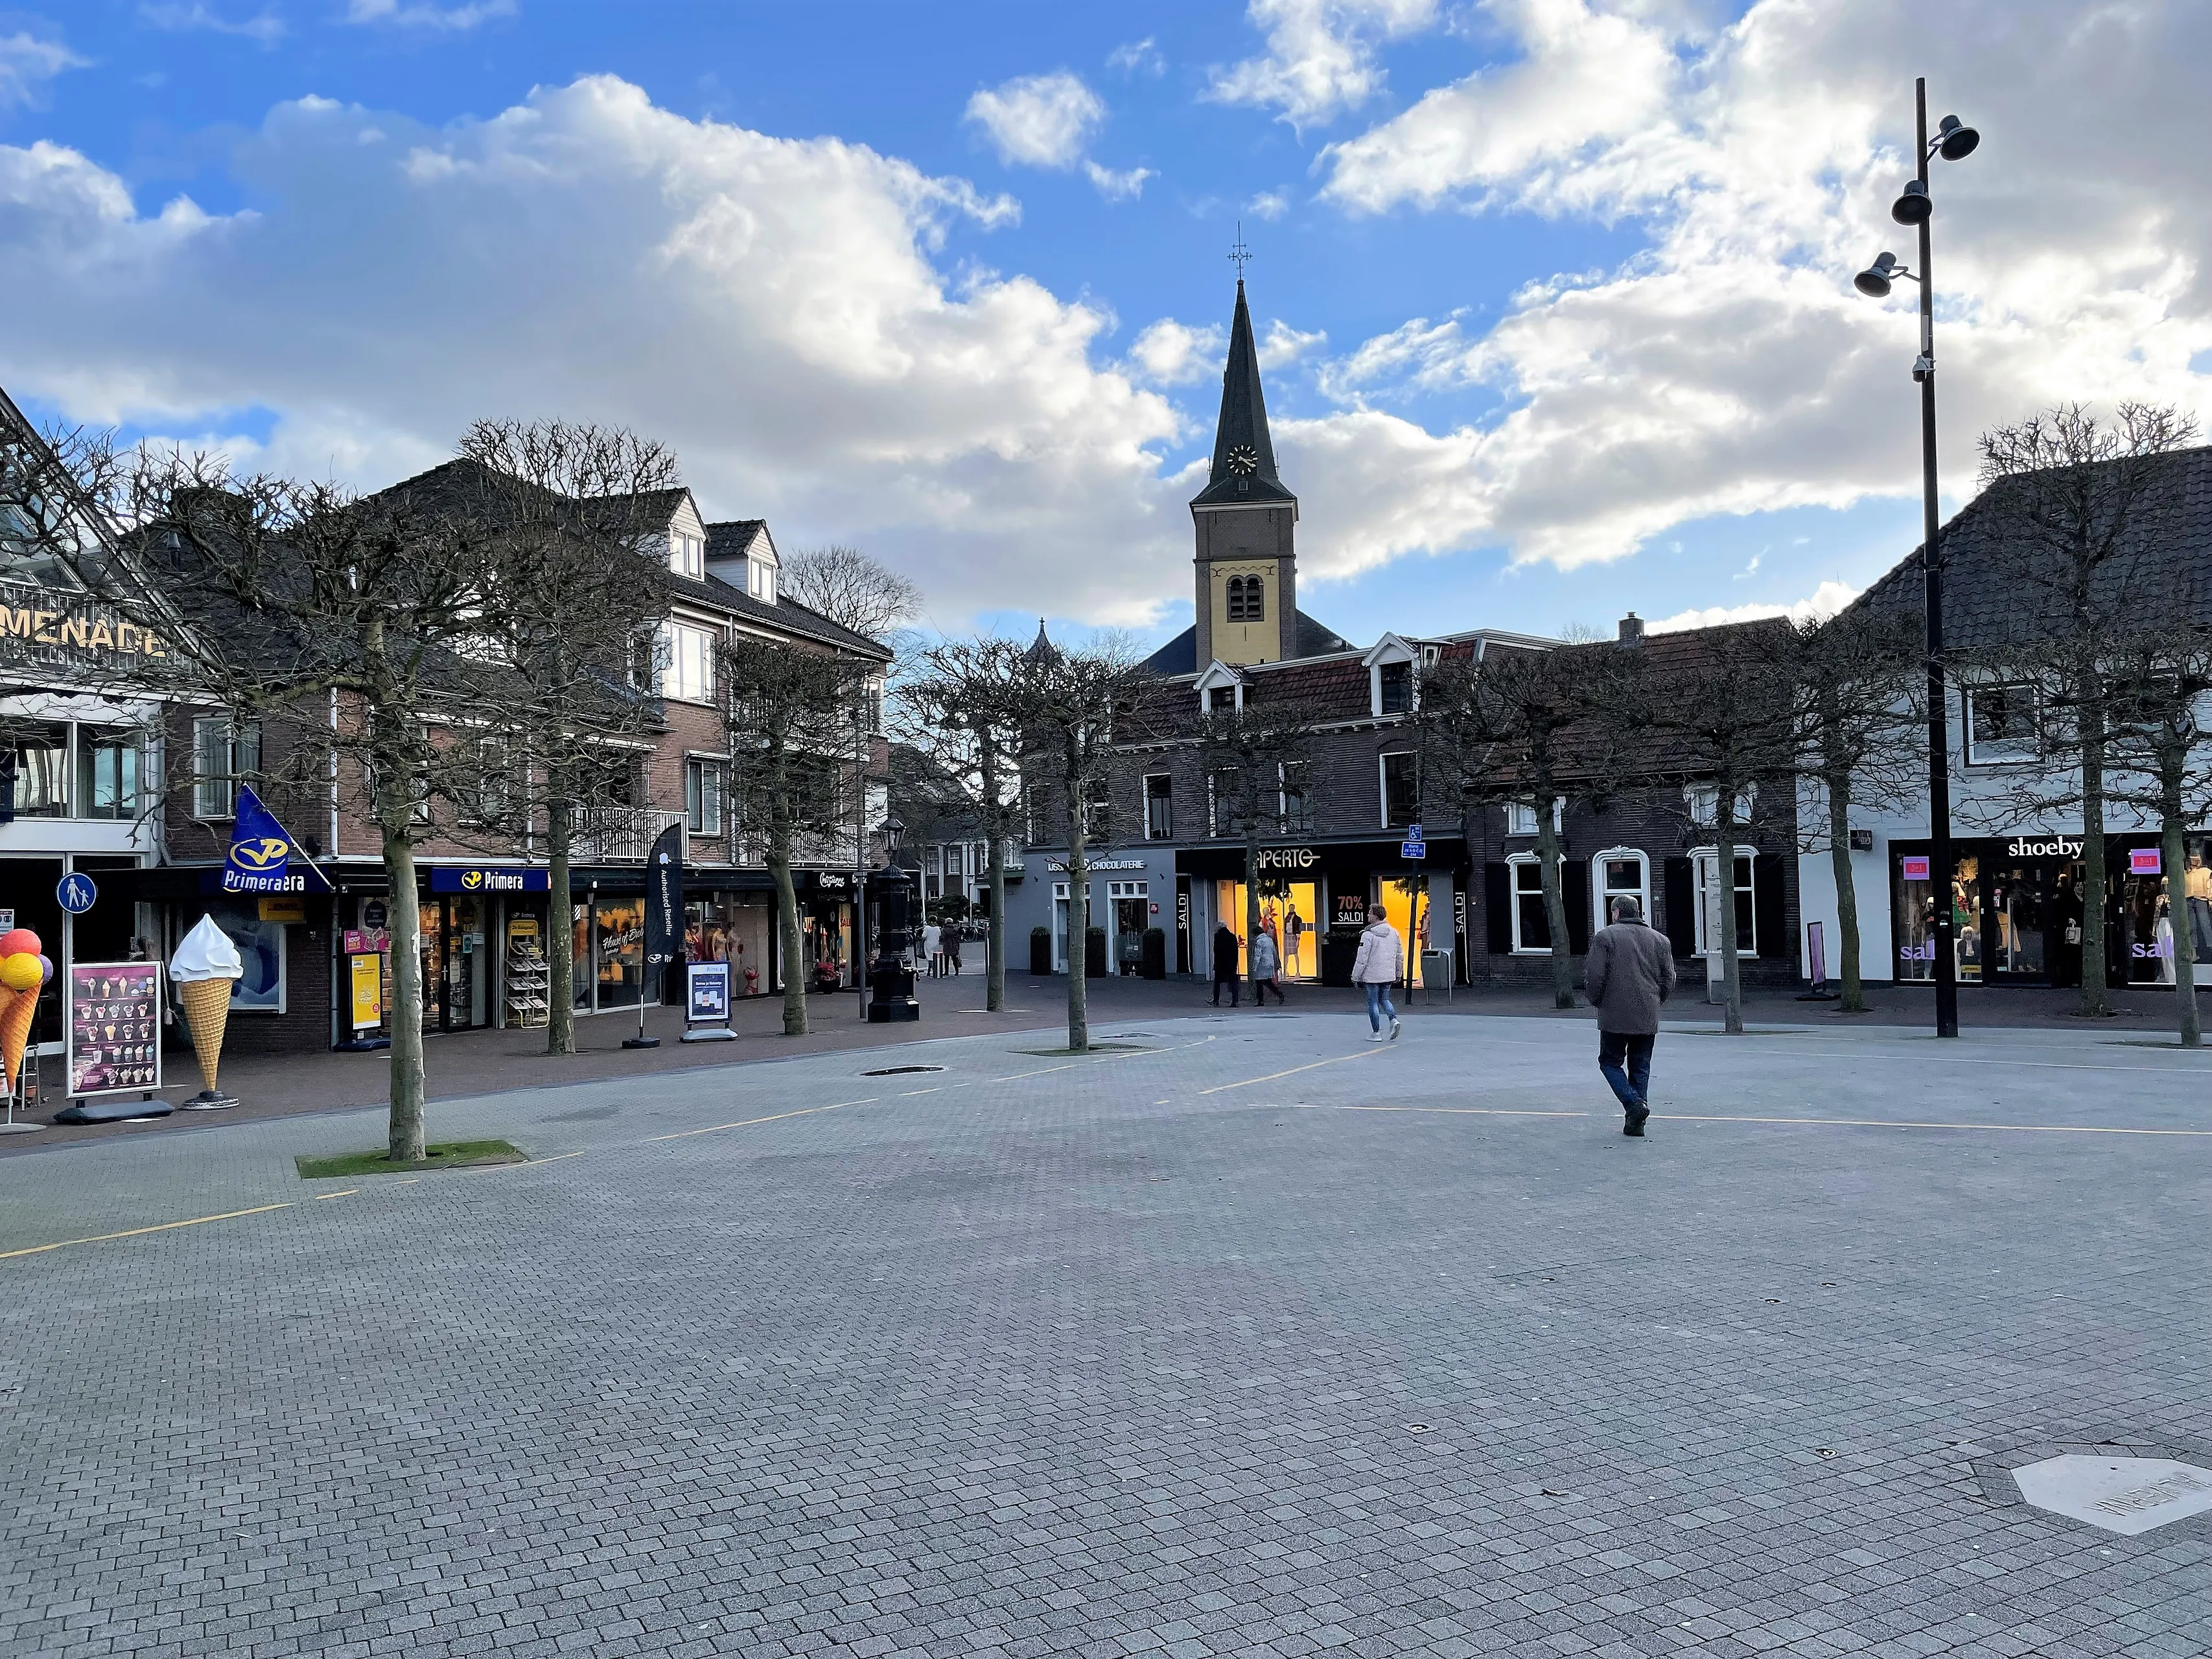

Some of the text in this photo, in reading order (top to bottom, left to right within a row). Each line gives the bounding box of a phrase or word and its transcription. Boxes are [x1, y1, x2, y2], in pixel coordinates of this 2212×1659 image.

[2008, 836, 2085, 859] shoeby
[1091, 860, 1145, 870] CHOCOLATERIE
[224, 870, 283, 891] Primera
[485, 871, 523, 889] Primera
[661, 869, 673, 936] Authorised Reseller
[1178, 894, 1187, 929] SALDI
[1338, 896, 1363, 910] 70%
[1338, 912, 1364, 922] SALDI
[1455, 892, 1464, 933] SALDI
[622, 931, 629, 947] of
